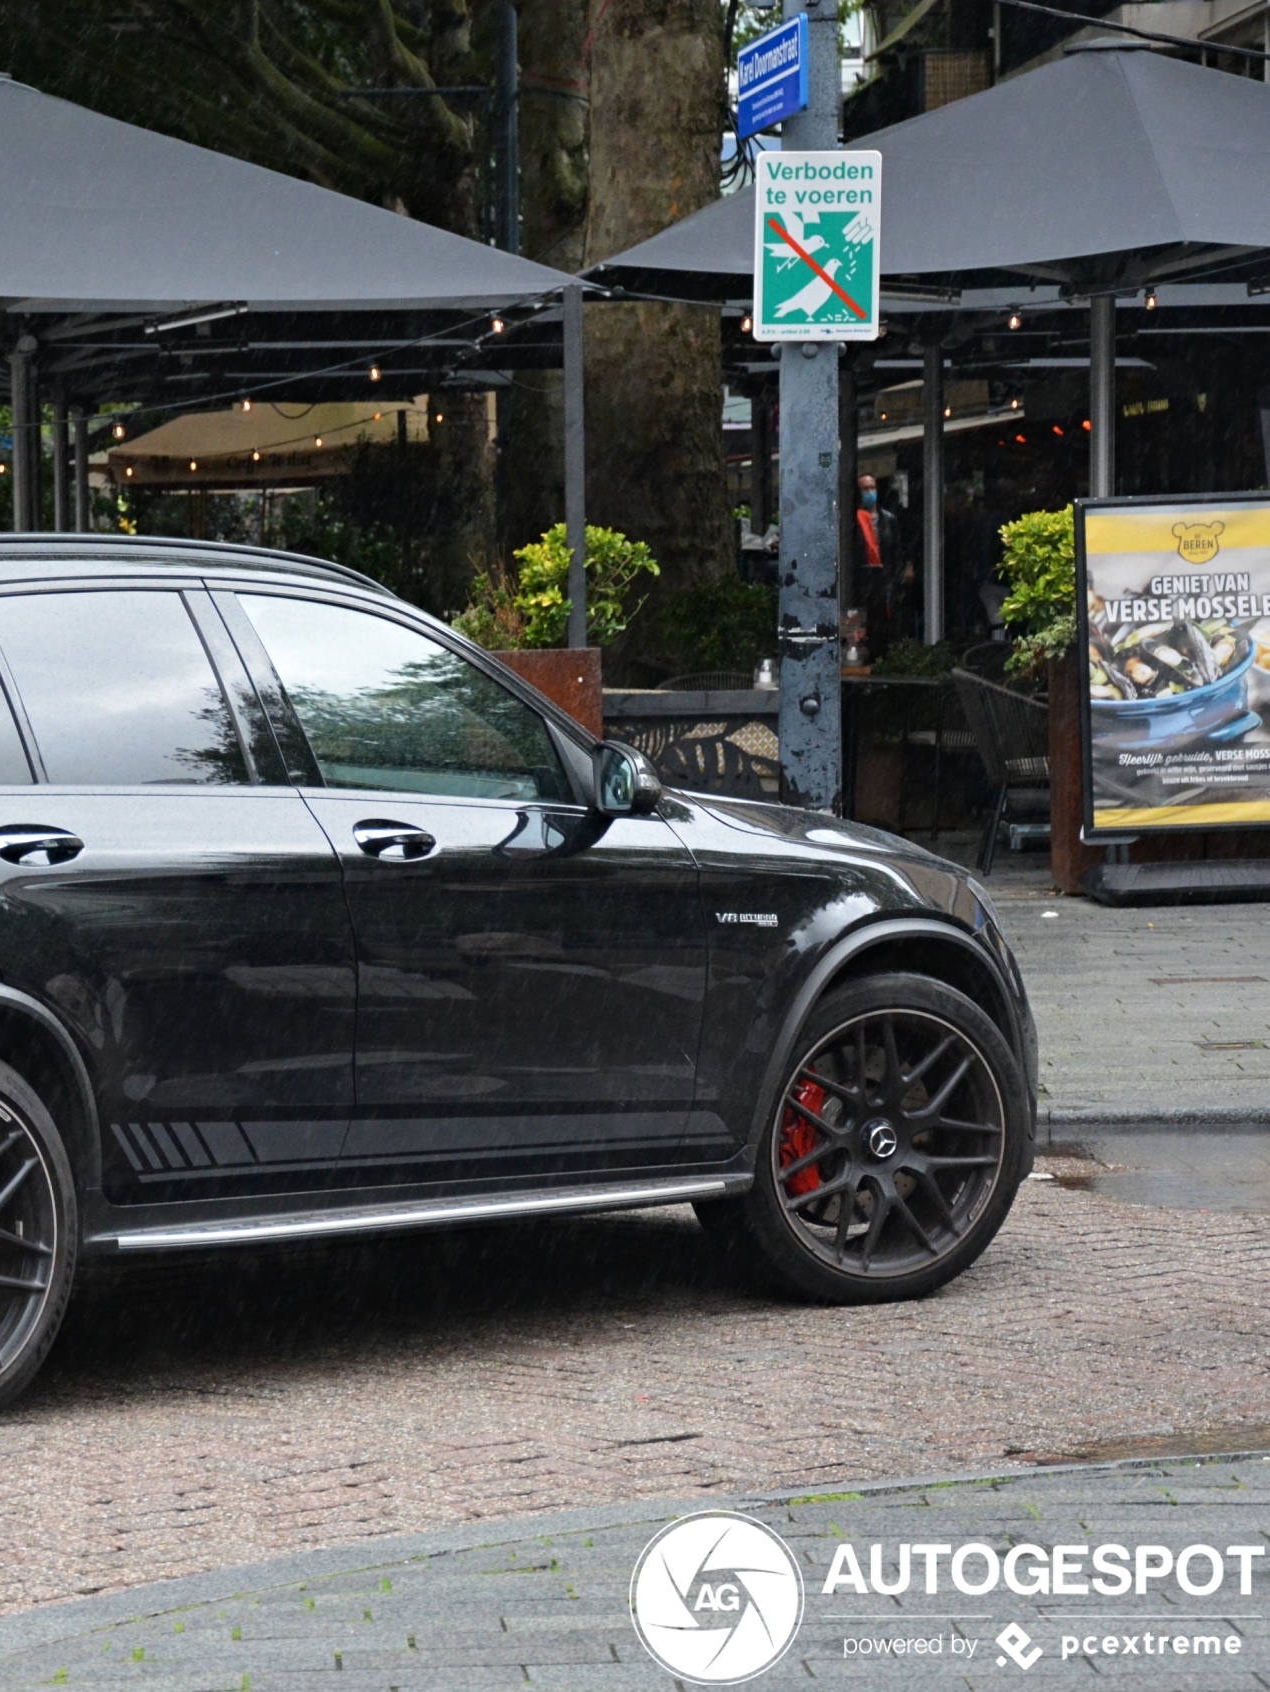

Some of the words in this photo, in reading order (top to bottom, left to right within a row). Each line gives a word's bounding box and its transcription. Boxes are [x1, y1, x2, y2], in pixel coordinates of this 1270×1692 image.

[739, 56, 755, 88] Karel
[755, 30, 798, 80] Doormanstraat
[766, 161, 873, 181] Verboden
[766, 187, 787, 205] te
[794, 189, 873, 205] voeren
[1183, 539, 1214, 550] BEREN
[1151, 575, 1210, 595] GENIET
[1213, 573, 1249, 592] VAN
[1105, 599, 1173, 622] VERSE
[1178, 595, 1270, 620] MOSSELE
[1118, 753, 1164, 767] Heerlijk
[1215, 750, 1244, 761] VERSE
